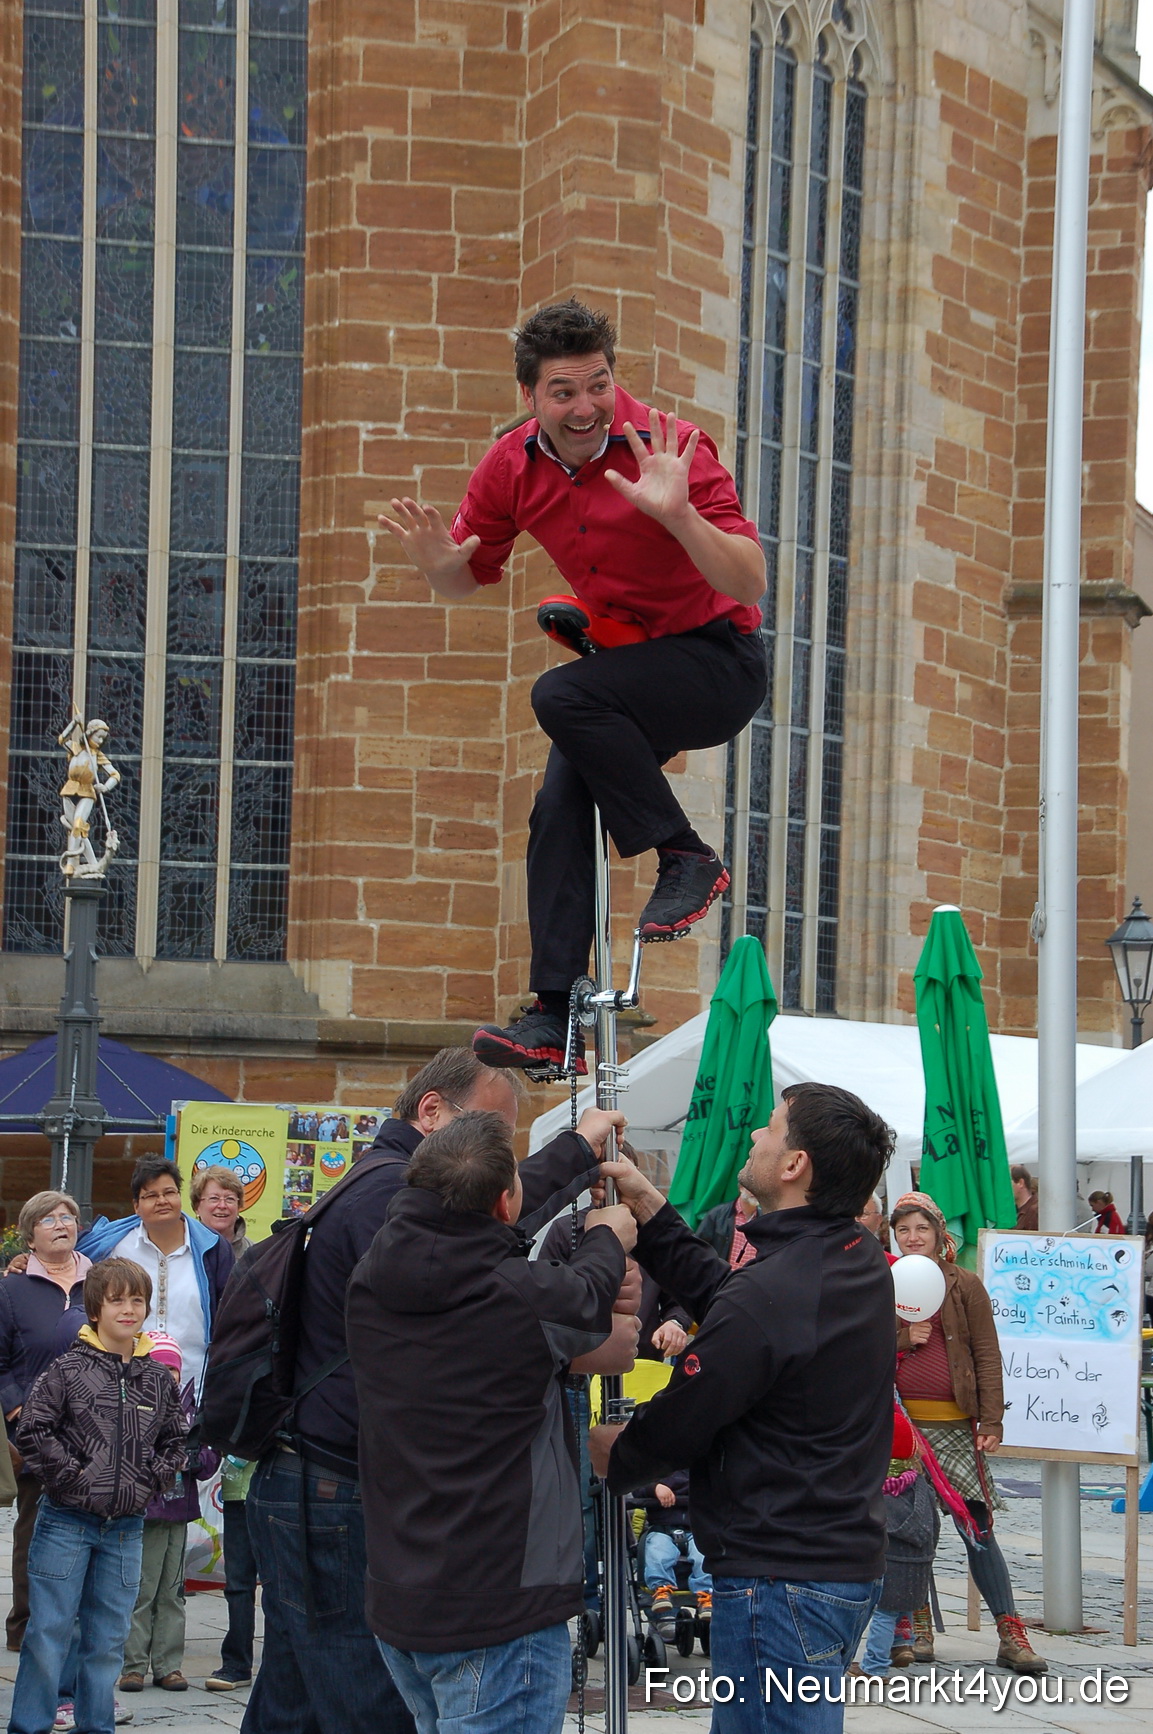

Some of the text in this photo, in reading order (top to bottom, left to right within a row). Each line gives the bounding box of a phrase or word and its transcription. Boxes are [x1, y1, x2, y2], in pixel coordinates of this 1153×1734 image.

[191, 1124, 275, 1138] Die Kinderarche
[994, 1246, 1108, 1271] Kinderschminken
[991, 1298, 1026, 1324] Body
[1075, 1361, 1103, 1382] der
[1026, 1393, 1080, 1423] Kirche
